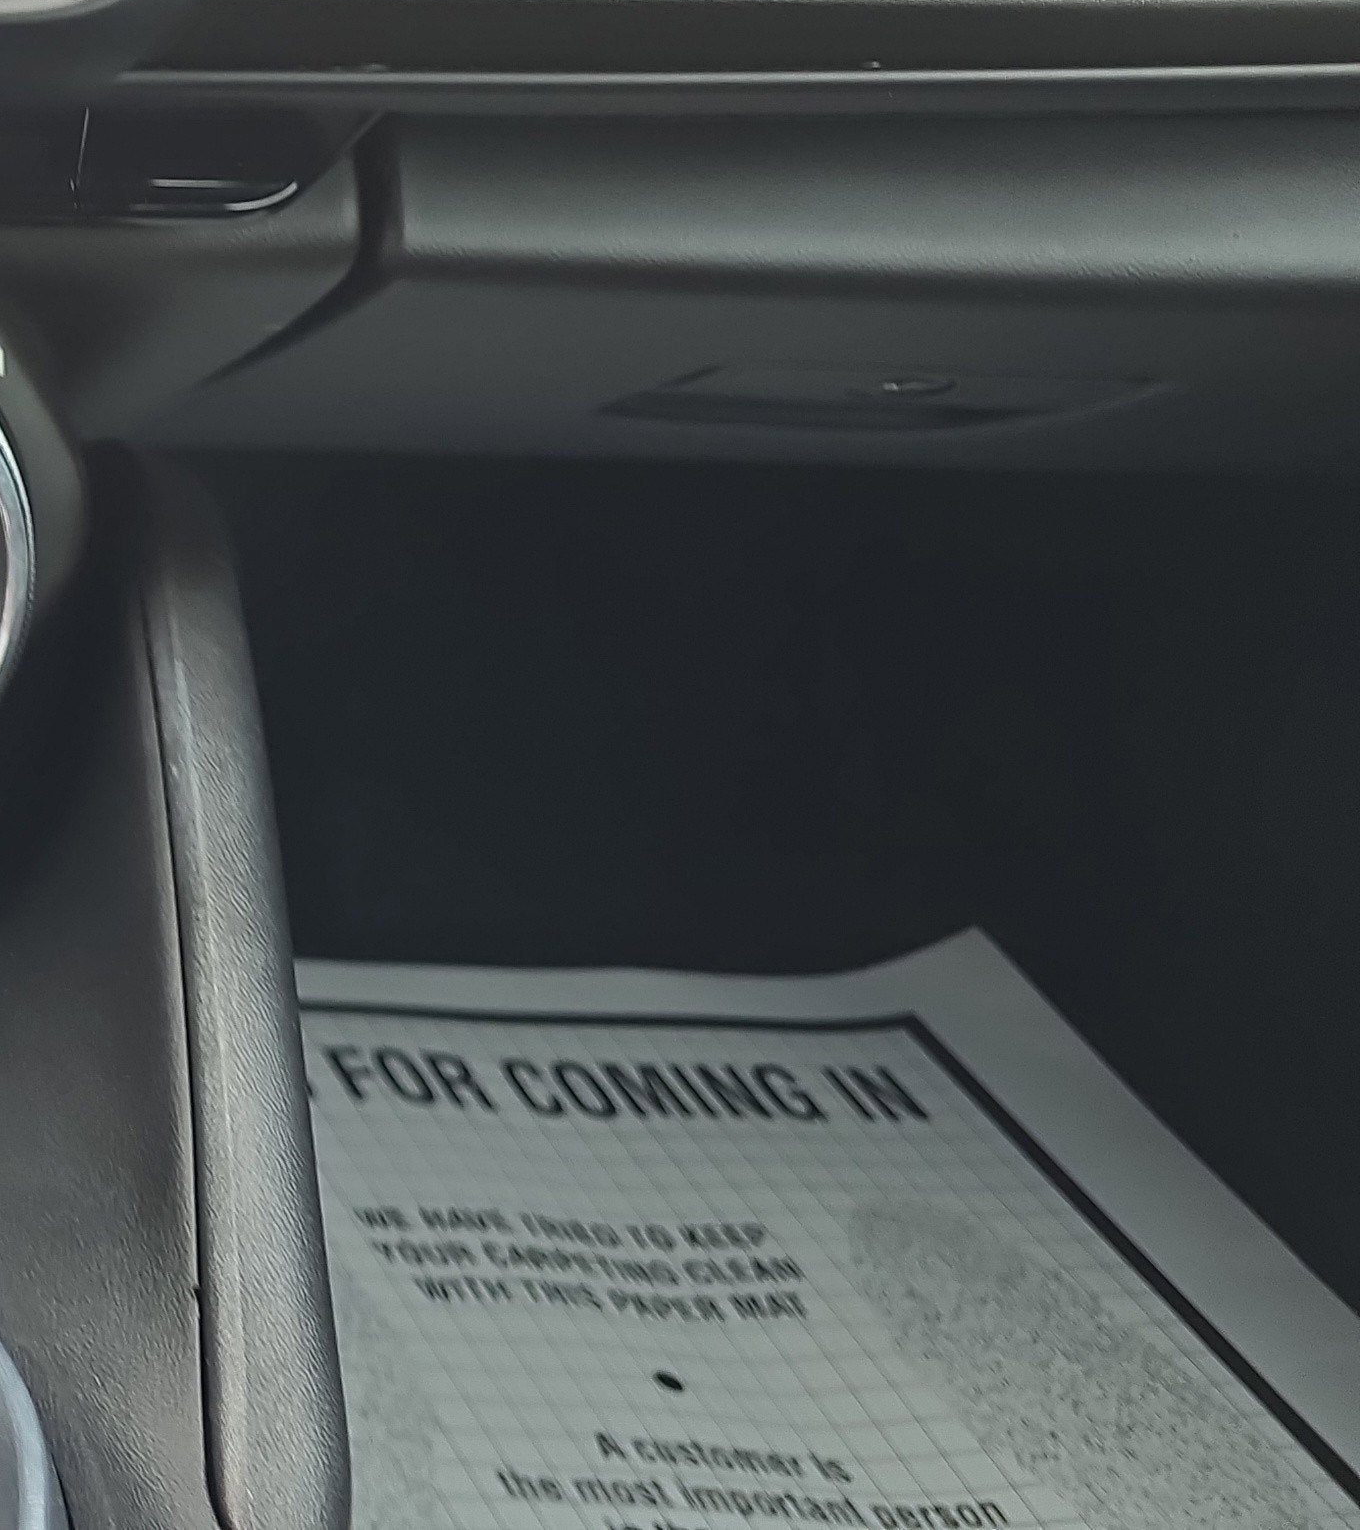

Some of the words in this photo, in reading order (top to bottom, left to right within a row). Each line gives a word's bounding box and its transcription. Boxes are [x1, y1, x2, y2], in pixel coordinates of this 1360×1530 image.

[323, 1044, 499, 1115] FOR
[500, 1055, 828, 1125] COMING
[821, 1064, 931, 1124] IN
[631, 1436, 807, 1477] customer
[495, 1469, 563, 1504] the
[573, 1477, 677, 1509] most
[677, 1476, 868, 1529] important
[870, 1499, 1011, 1530] person
